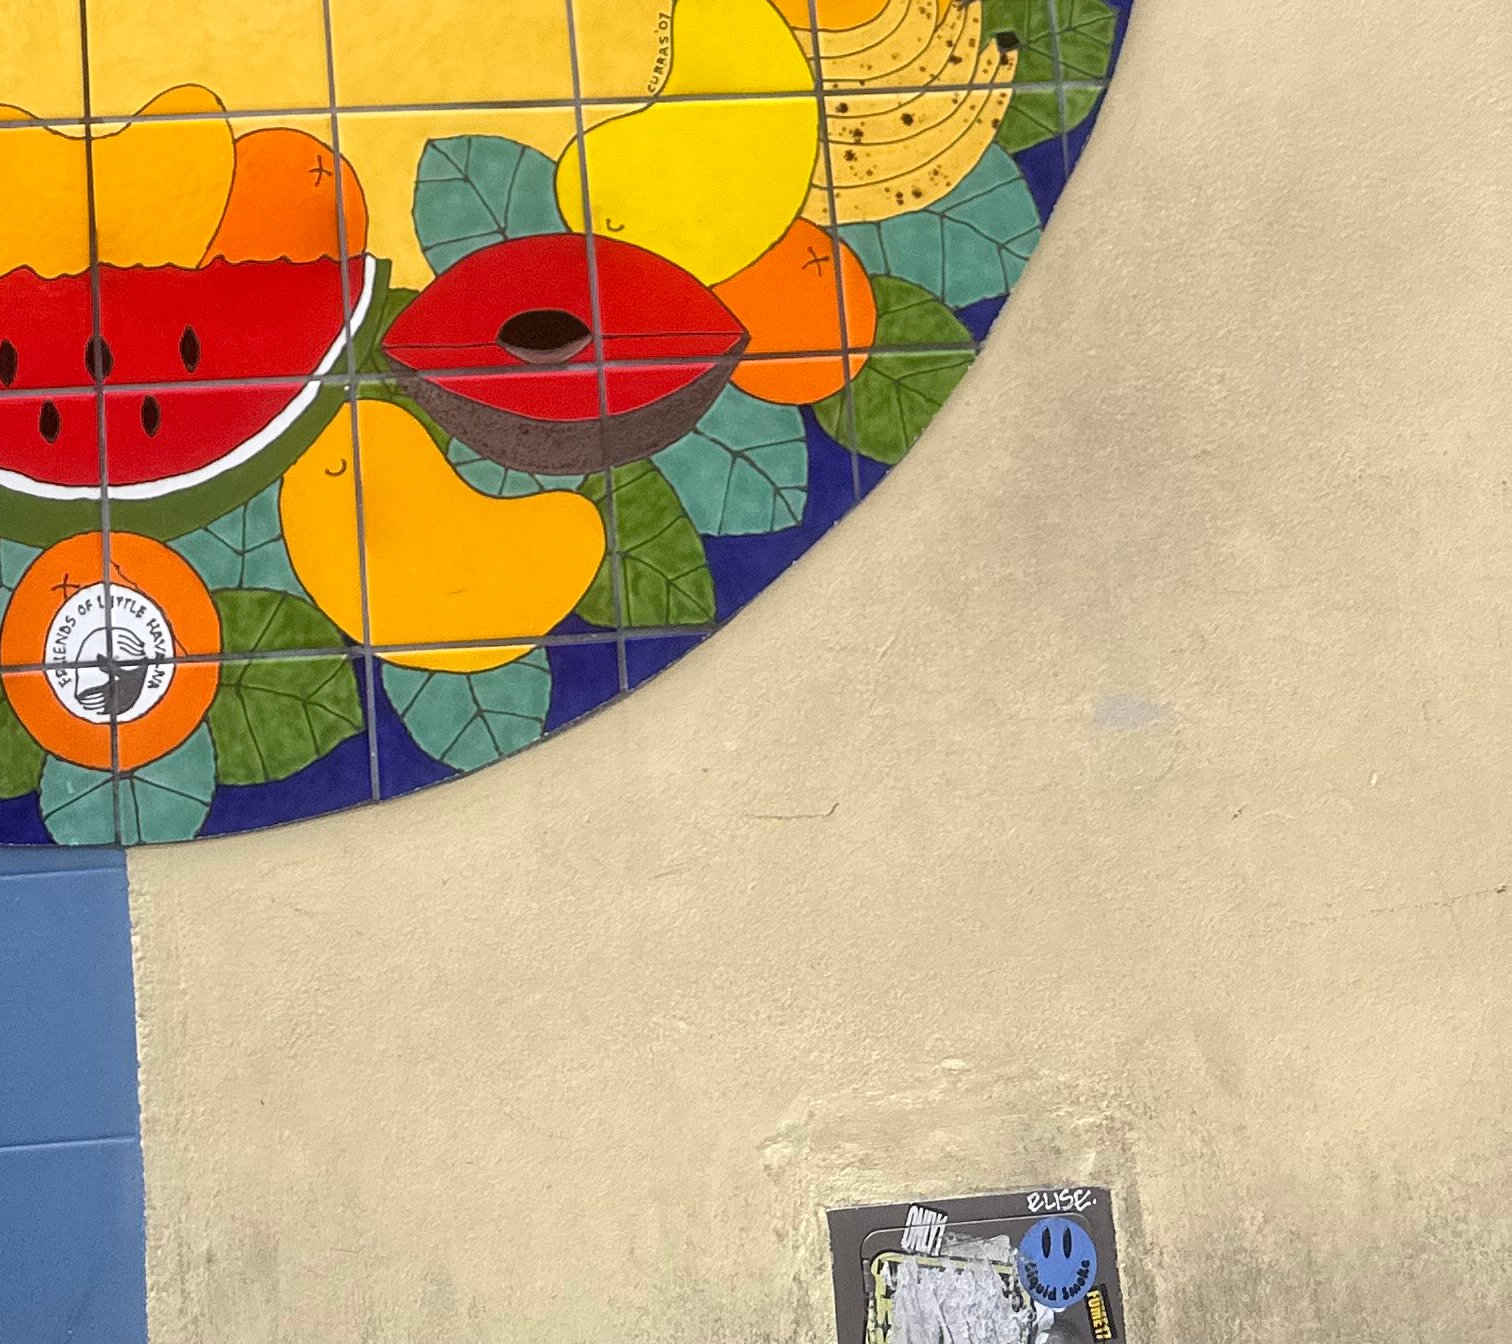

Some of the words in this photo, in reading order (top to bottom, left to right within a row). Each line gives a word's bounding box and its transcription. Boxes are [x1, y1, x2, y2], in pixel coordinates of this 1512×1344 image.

[648, 36, 669, 93] CURRAS
[53, 616, 76, 688] FRIENDS
[78, 599, 93, 616] OF
[97, 595, 147, 618] LITTLE
[146, 618, 167, 689] HAVANA
